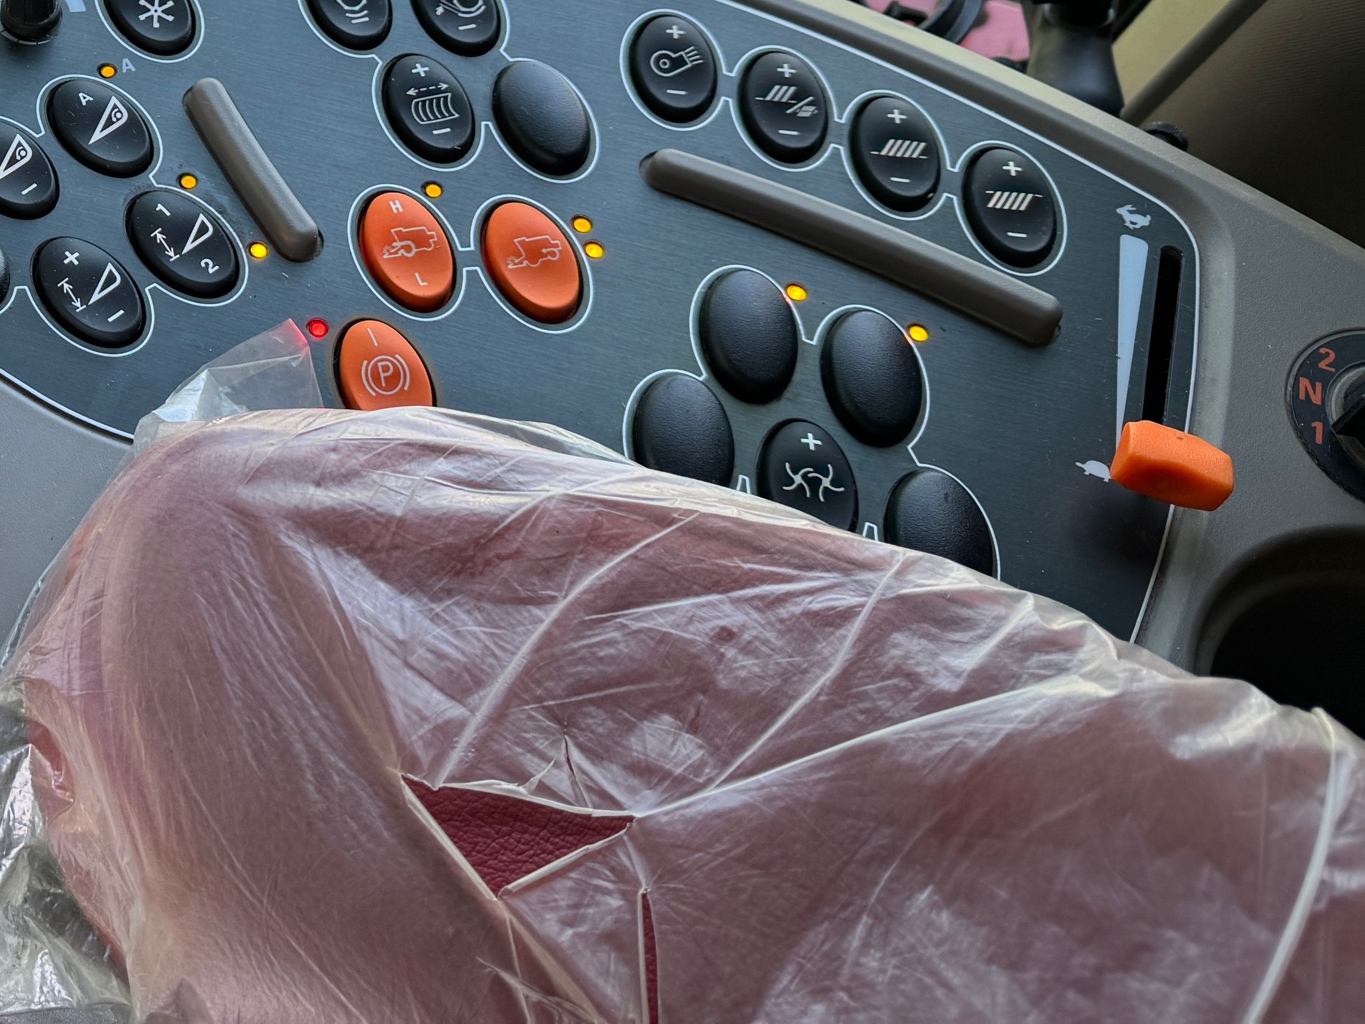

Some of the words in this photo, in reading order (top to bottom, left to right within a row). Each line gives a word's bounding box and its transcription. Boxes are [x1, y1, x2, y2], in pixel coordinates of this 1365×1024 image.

[122, 58, 136, 73] A
[78, 92, 94, 106] A
[155, 203, 171, 217] 1
[389, 199, 404, 214] H
[200, 258, 220, 274] 2
[414, 272, 428, 286] L
[1318, 347, 1335, 372] 2
[377, 361, 394, 387] P
[1299, 377, 1322, 406] N
[1311, 421, 1324, 445] 1
